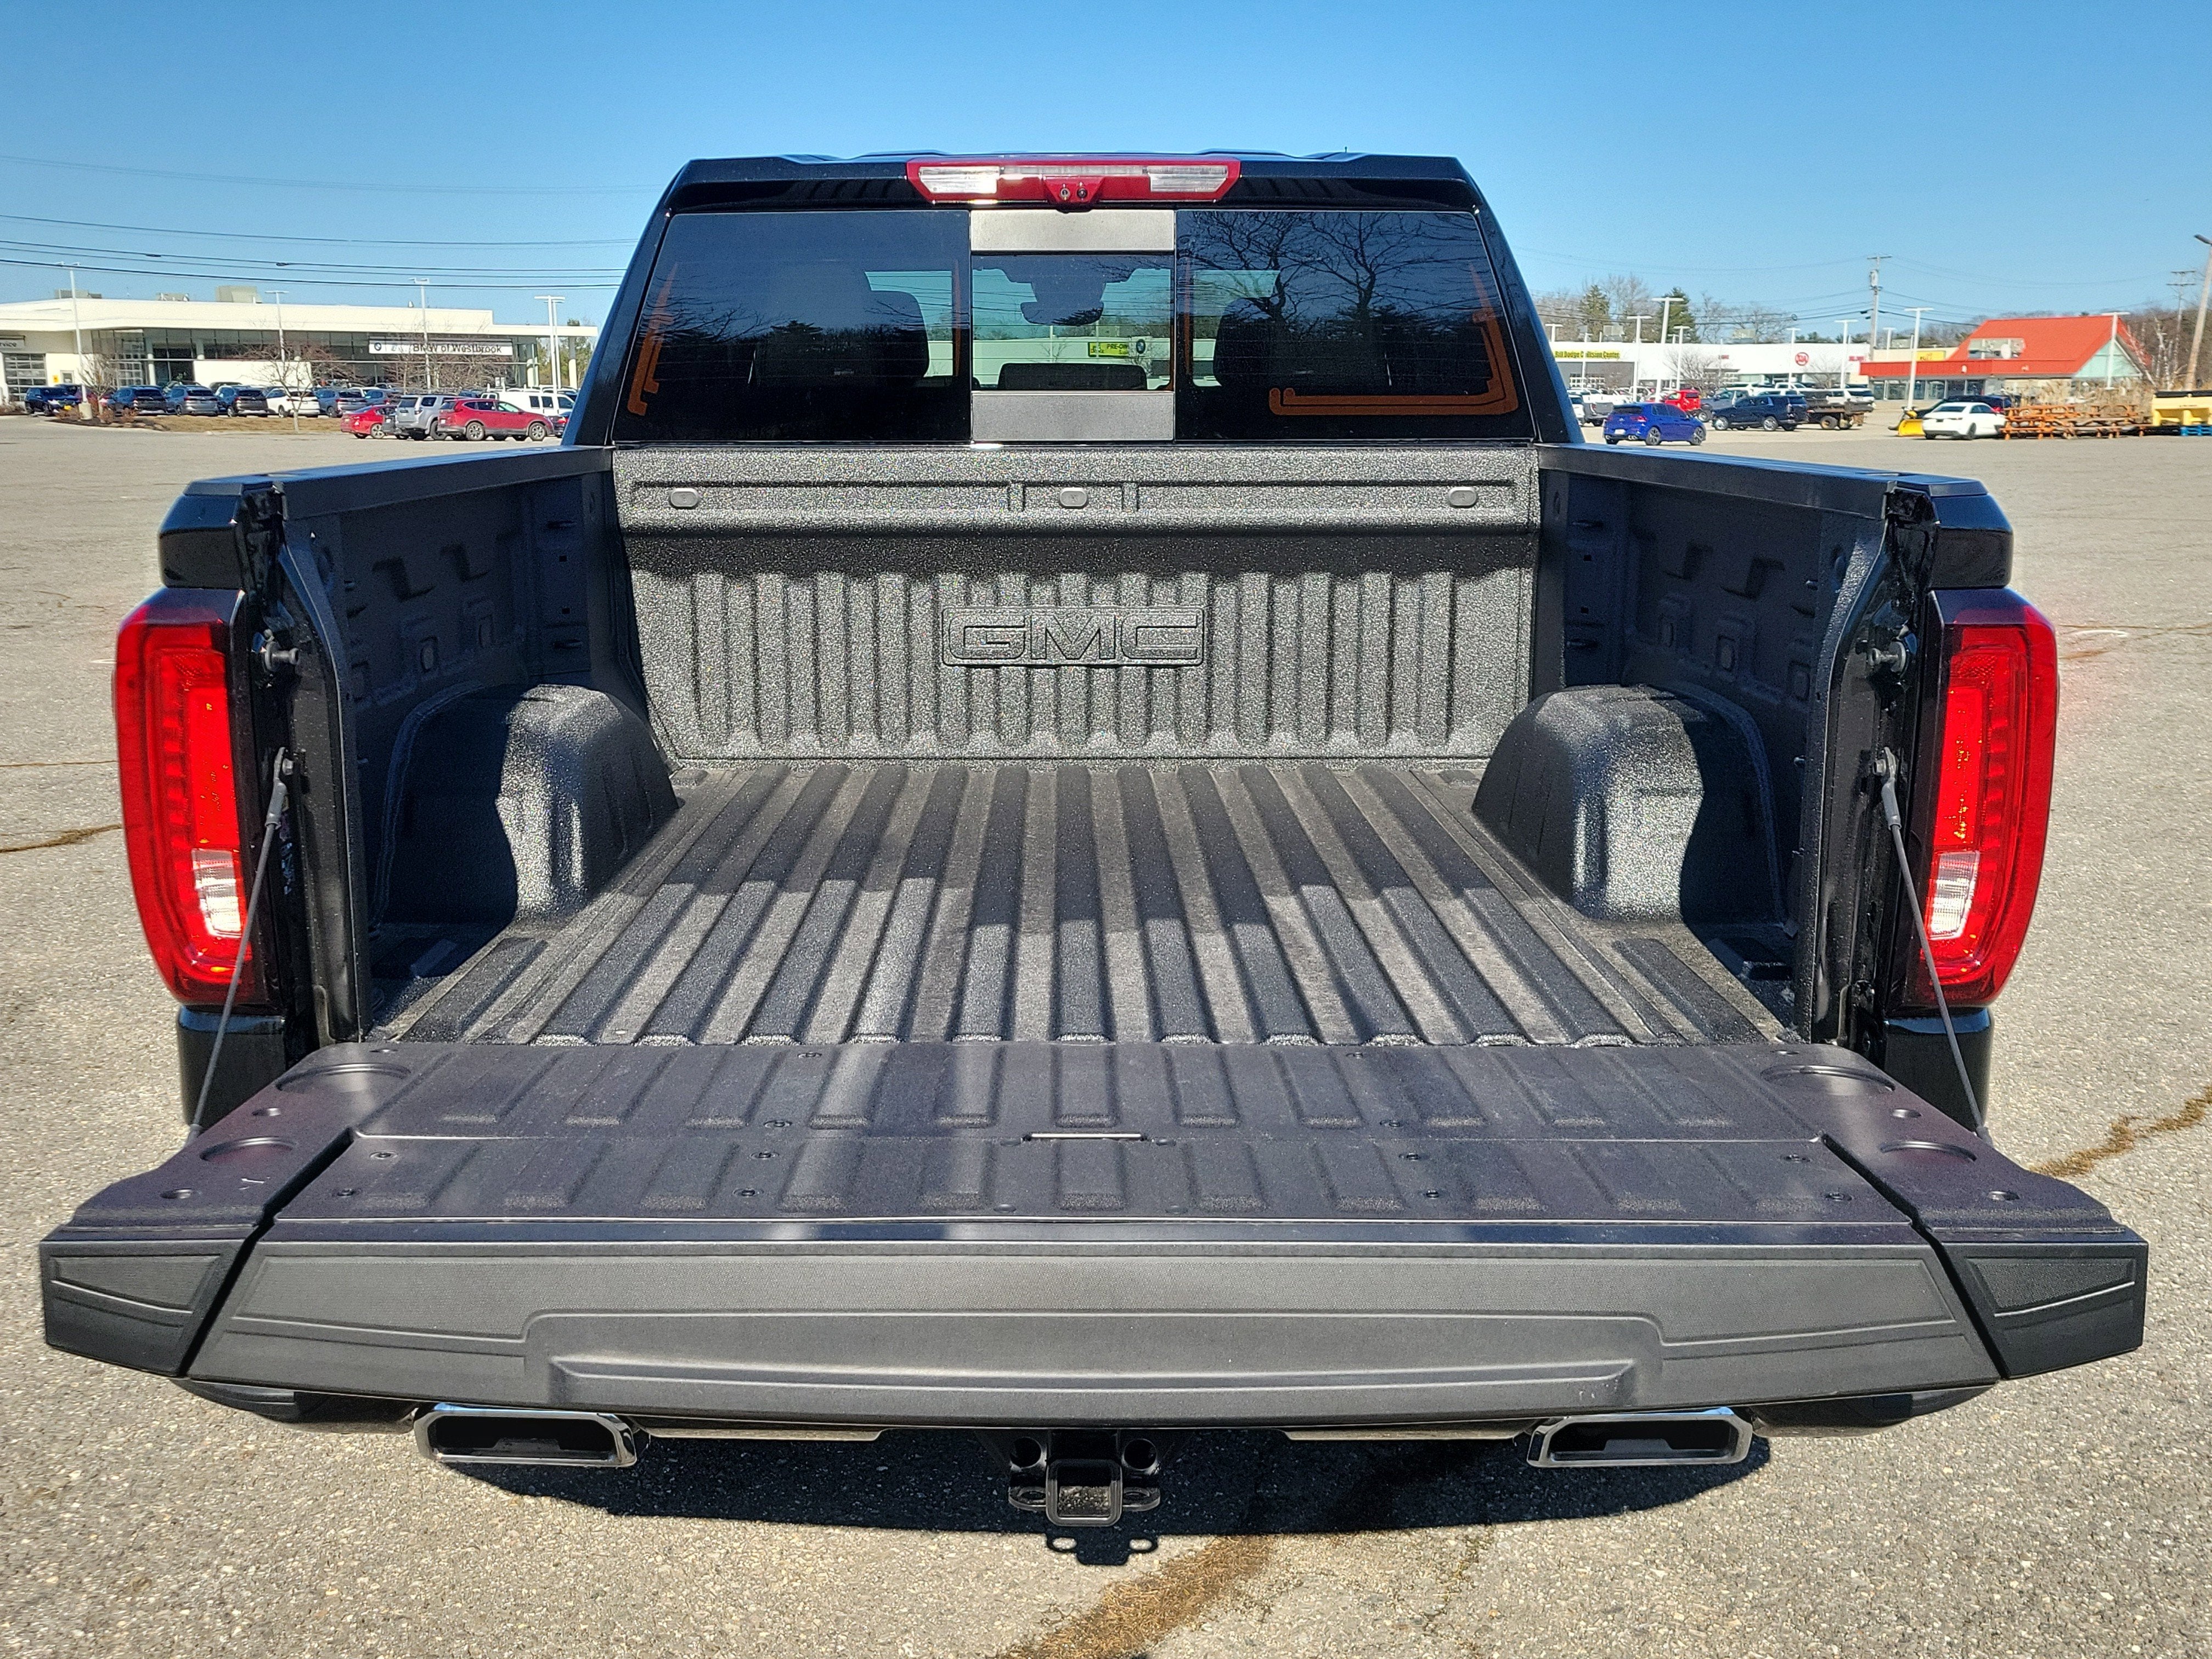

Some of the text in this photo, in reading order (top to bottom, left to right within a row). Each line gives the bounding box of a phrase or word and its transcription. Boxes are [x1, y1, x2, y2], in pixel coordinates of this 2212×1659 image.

[441, 344, 450, 352] of
[452, 344, 501, 353] Westbrook
[949, 614, 1198, 660] GMC
